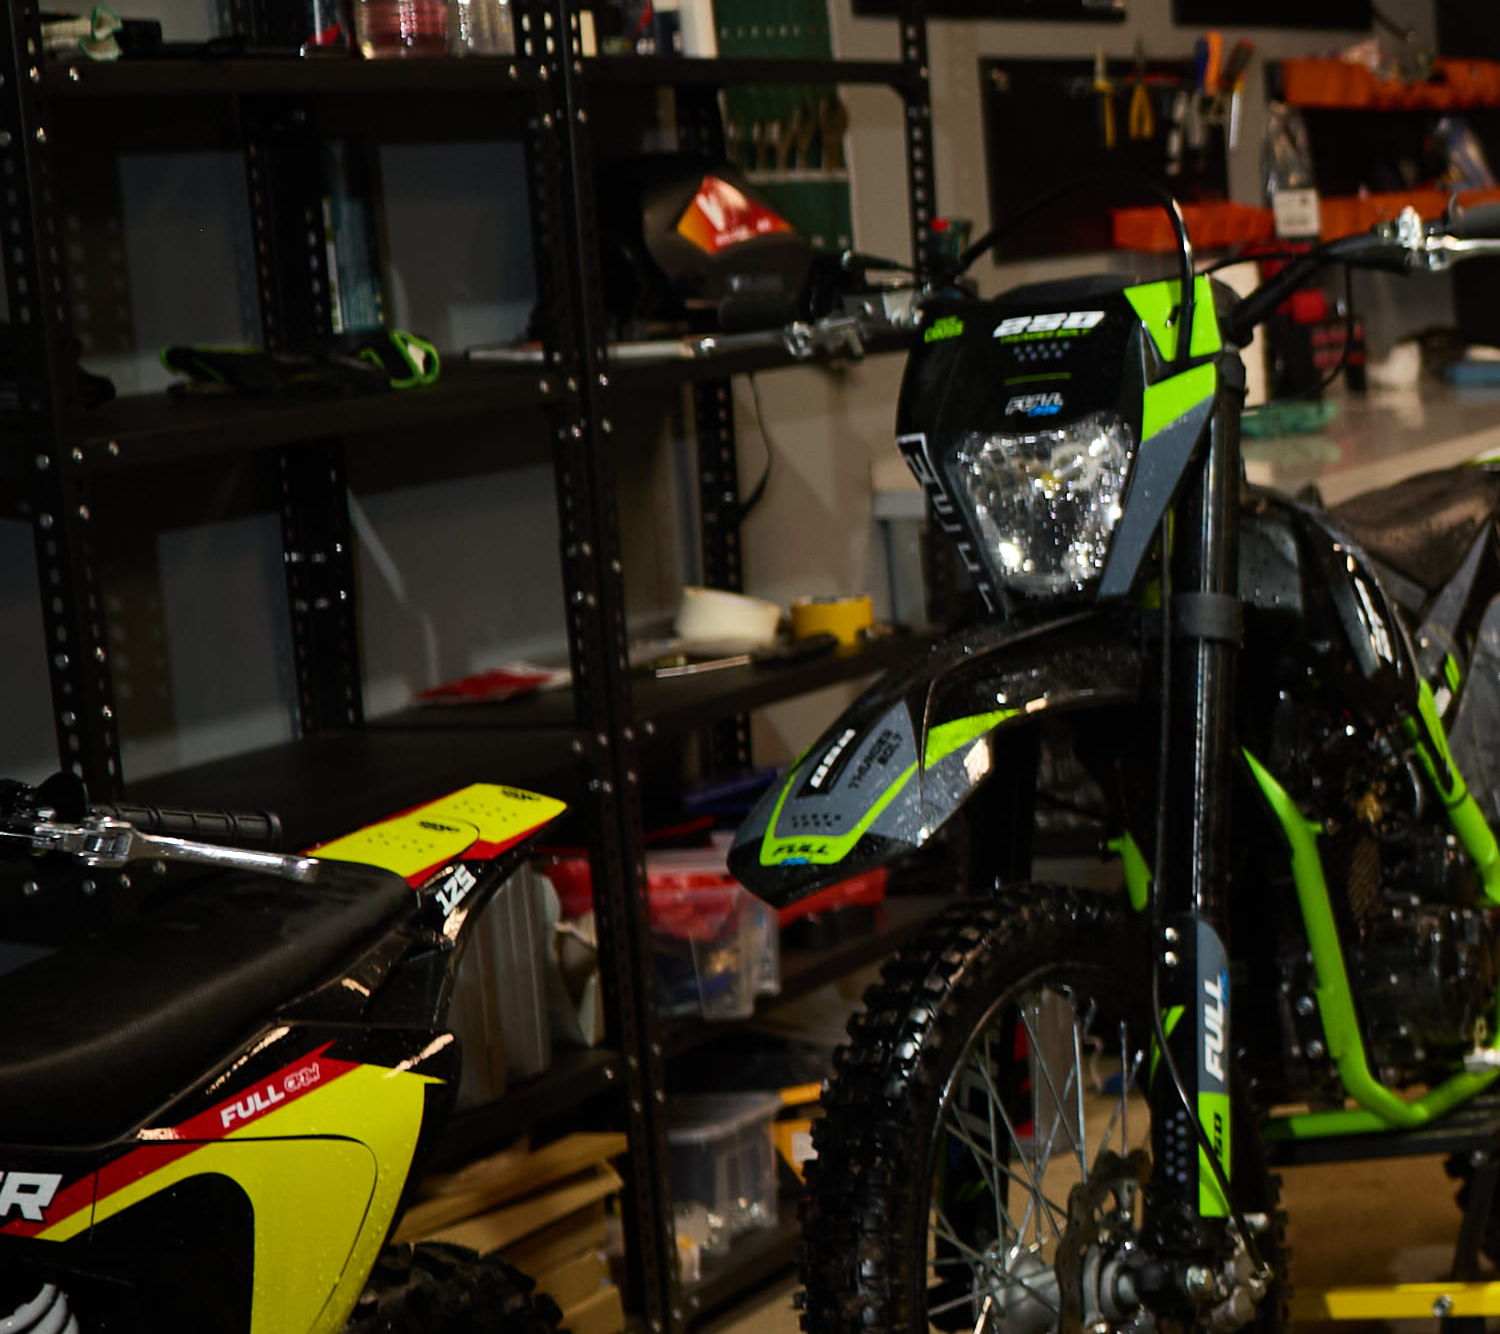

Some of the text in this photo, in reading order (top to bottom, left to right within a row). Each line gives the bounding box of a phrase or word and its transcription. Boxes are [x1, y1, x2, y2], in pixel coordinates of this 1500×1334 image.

[435, 864, 477, 917] 125
[1203, 975, 1226, 1083] FULL
[220, 1084, 285, 1129] FULL
